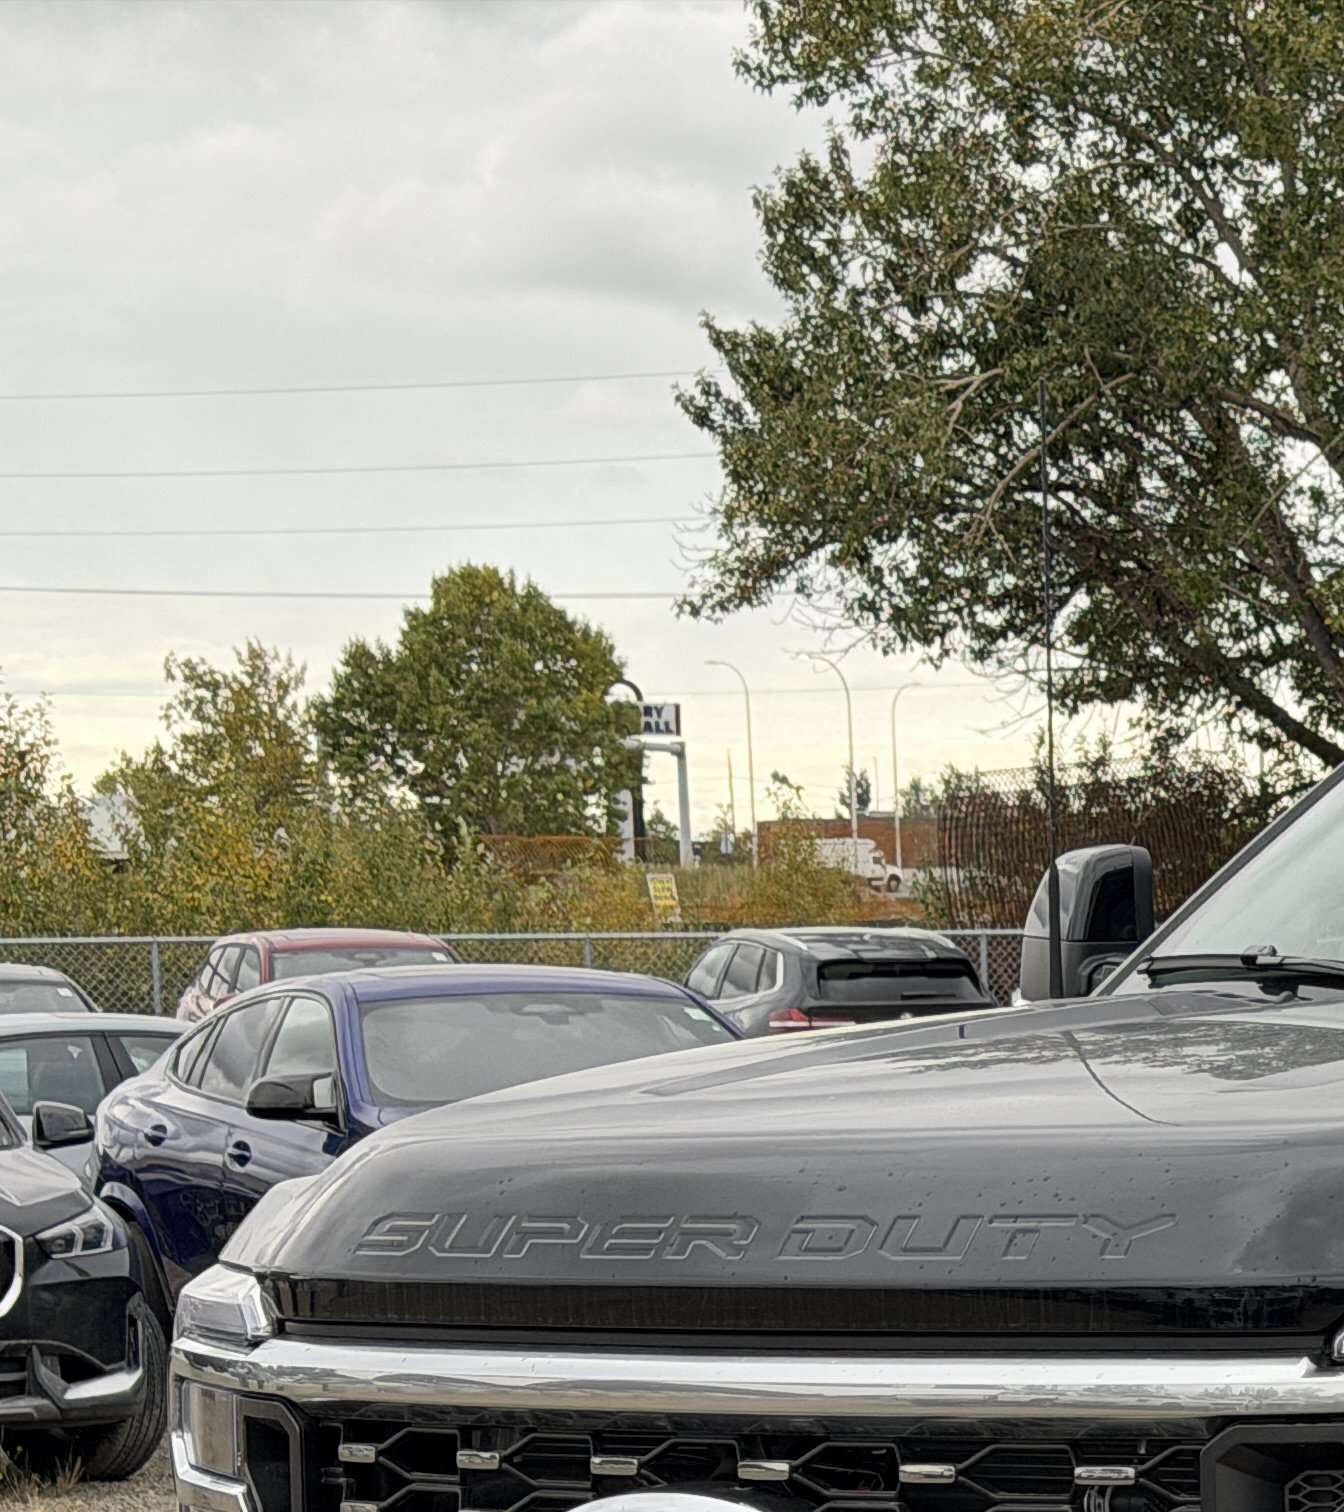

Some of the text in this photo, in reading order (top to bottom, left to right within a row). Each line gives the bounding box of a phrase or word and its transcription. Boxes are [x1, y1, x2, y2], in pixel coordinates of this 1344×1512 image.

[642, 705, 665, 719] RY
[642, 720, 674, 734] ALL
[353, 1212, 1178, 1261] SUPER DUTY
